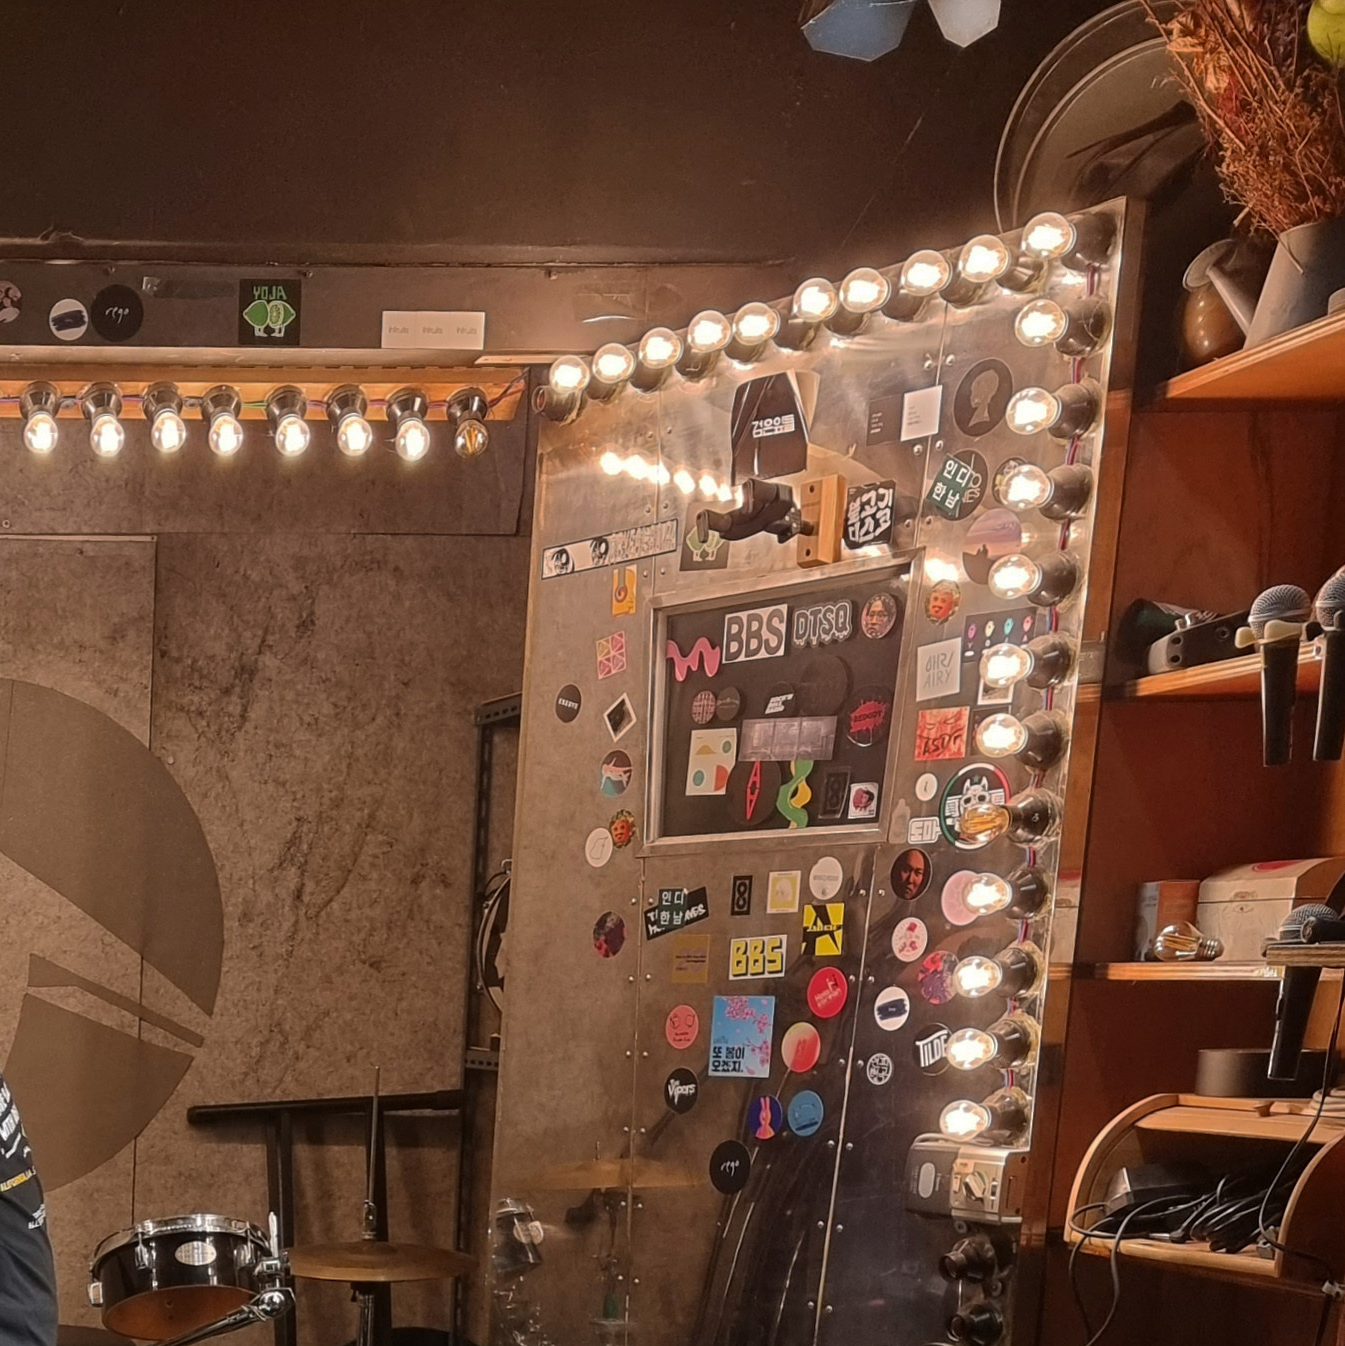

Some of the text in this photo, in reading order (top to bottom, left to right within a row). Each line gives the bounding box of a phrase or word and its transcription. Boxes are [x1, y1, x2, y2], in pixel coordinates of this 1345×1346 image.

[253, 286, 288, 300] YOJA
[105, 307, 130, 324] rego
[793, 601, 852, 647] DTSQ
[724, 608, 785, 662] BBS
[923, 669, 953, 690] AIRY
[661, 890, 684, 906] 인디
[660, 911, 684, 925] 한남
[731, 937, 784, 977] BBS
[712, 1046, 745, 1060] 또 봄이
[667, 1083, 697, 1106] Vipers
[720, 1159, 740, 1177] rego
